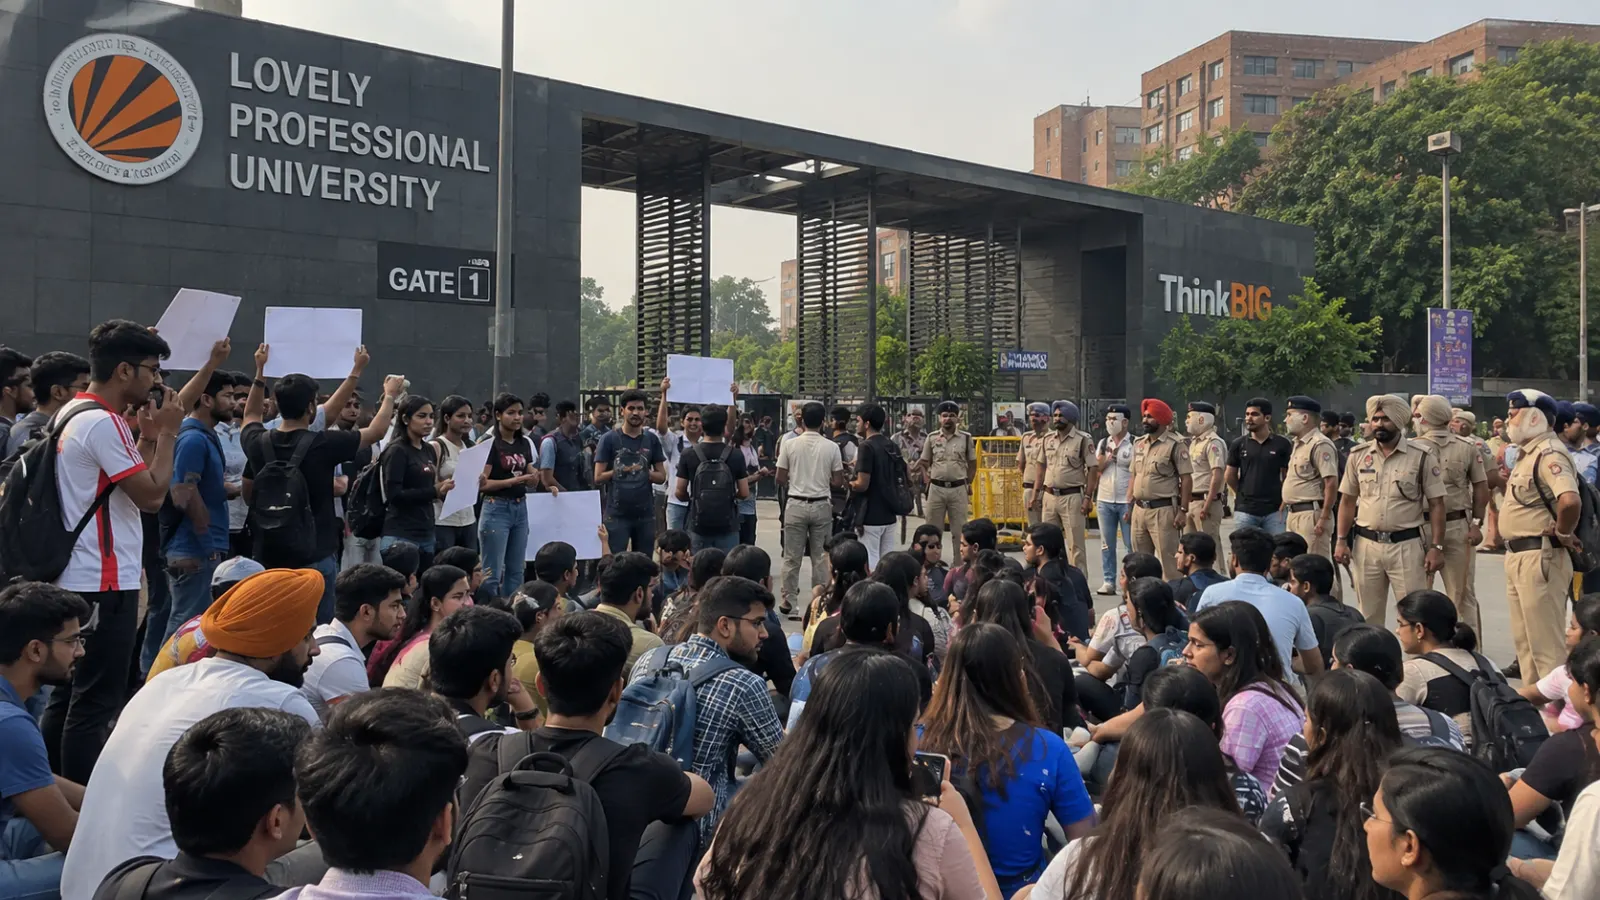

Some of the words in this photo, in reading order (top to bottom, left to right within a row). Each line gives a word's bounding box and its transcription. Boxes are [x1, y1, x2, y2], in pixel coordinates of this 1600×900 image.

[230, 52, 371, 107] LOVELY
[230, 103, 490, 173] PROFESSIONAL
[230, 153, 441, 211] UNIVERSITY
[389, 267, 455, 294] GATE
[469, 272, 479, 296] 1
